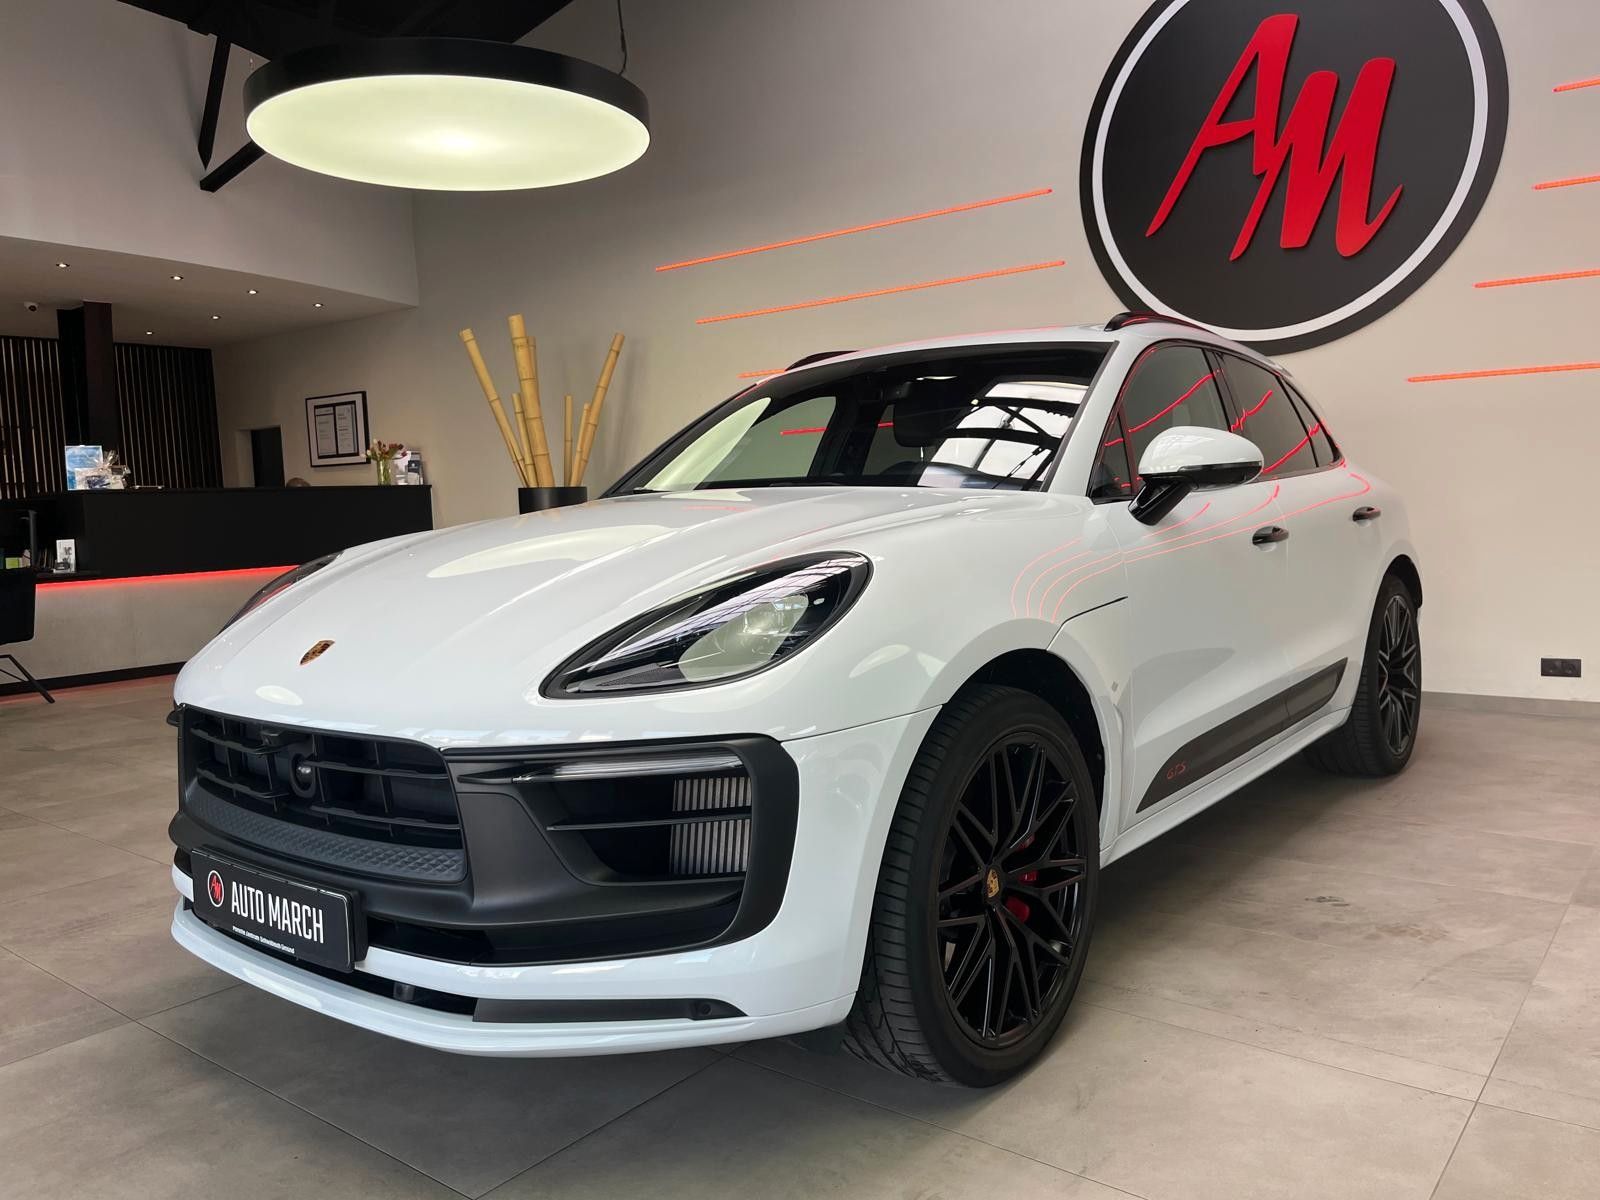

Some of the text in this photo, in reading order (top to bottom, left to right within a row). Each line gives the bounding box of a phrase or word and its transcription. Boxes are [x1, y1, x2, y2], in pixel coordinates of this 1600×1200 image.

[1145, 13, 1403, 262] AM
[231, 881, 265, 924] AUTO
[268, 893, 324, 944] MARCH
